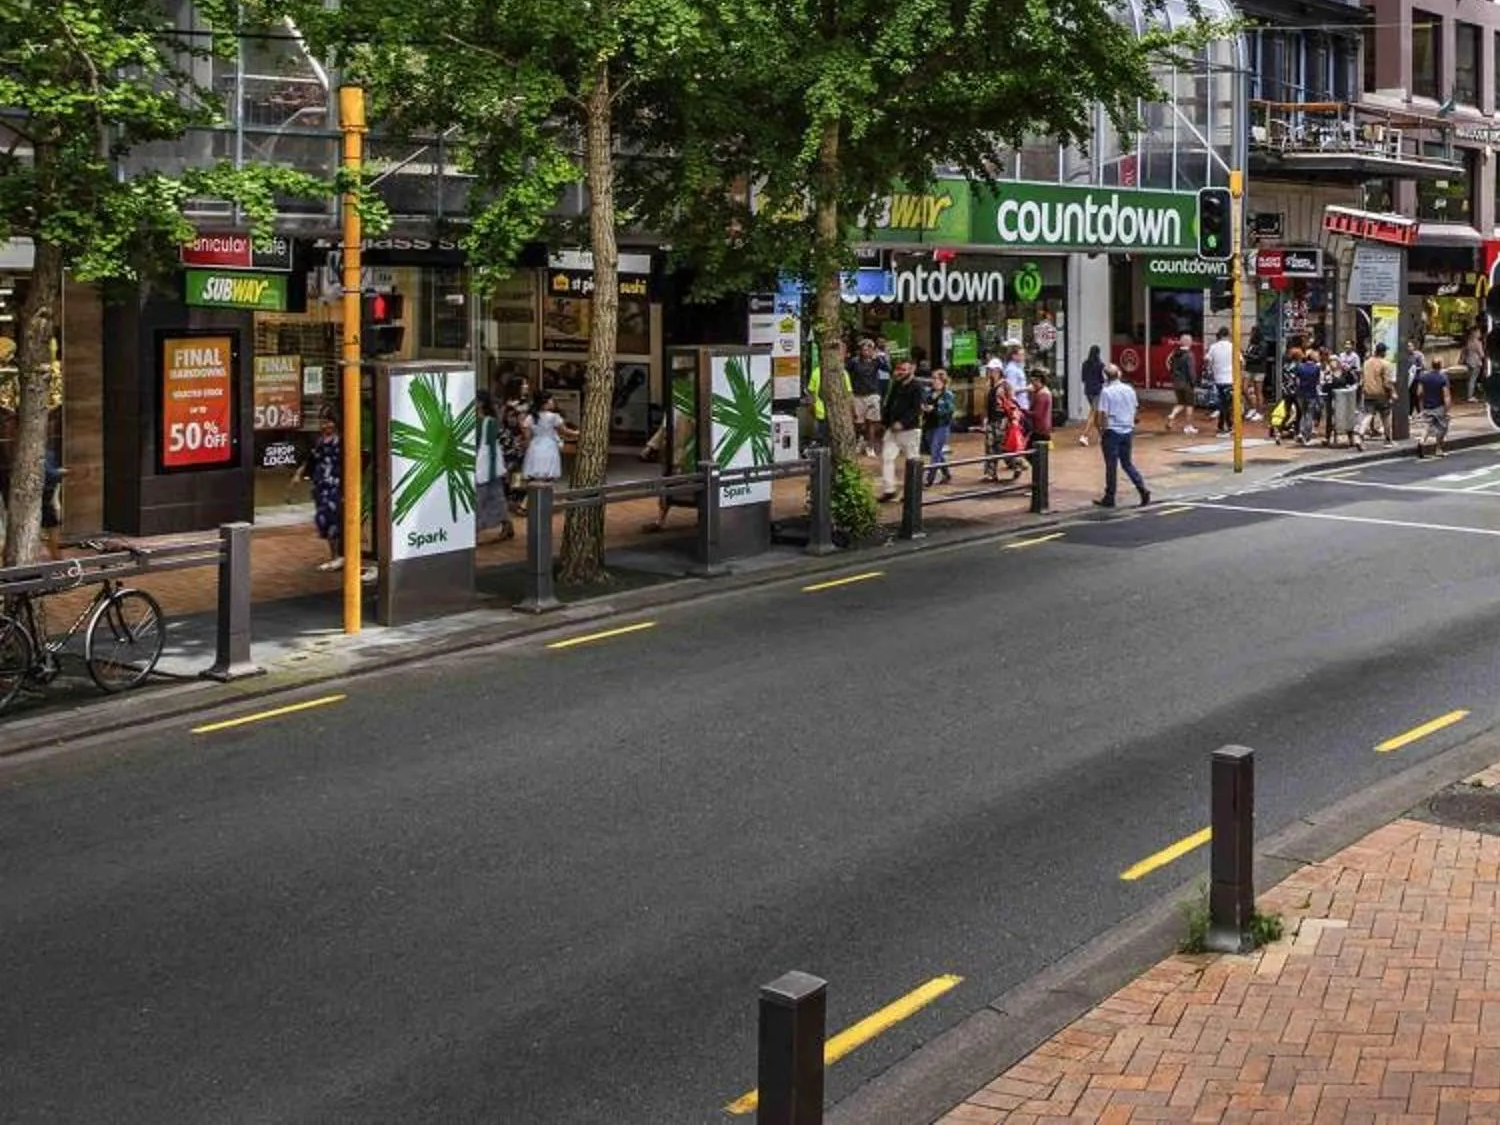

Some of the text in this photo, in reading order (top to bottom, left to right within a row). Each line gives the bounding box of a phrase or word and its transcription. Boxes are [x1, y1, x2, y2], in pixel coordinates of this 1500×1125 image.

[997, 194, 1181, 245] countdown
[1150, 258, 1227, 275] countdown
[203, 277, 269, 302] SUBWAY
[174, 348, 223, 367] FINAL
[204, 432, 228, 449] OFF
[265, 445, 296, 456] SHOP
[263, 455, 297, 467] LOCAL
[723, 484, 752, 500] Spark
[407, 527, 448, 549] Spark
